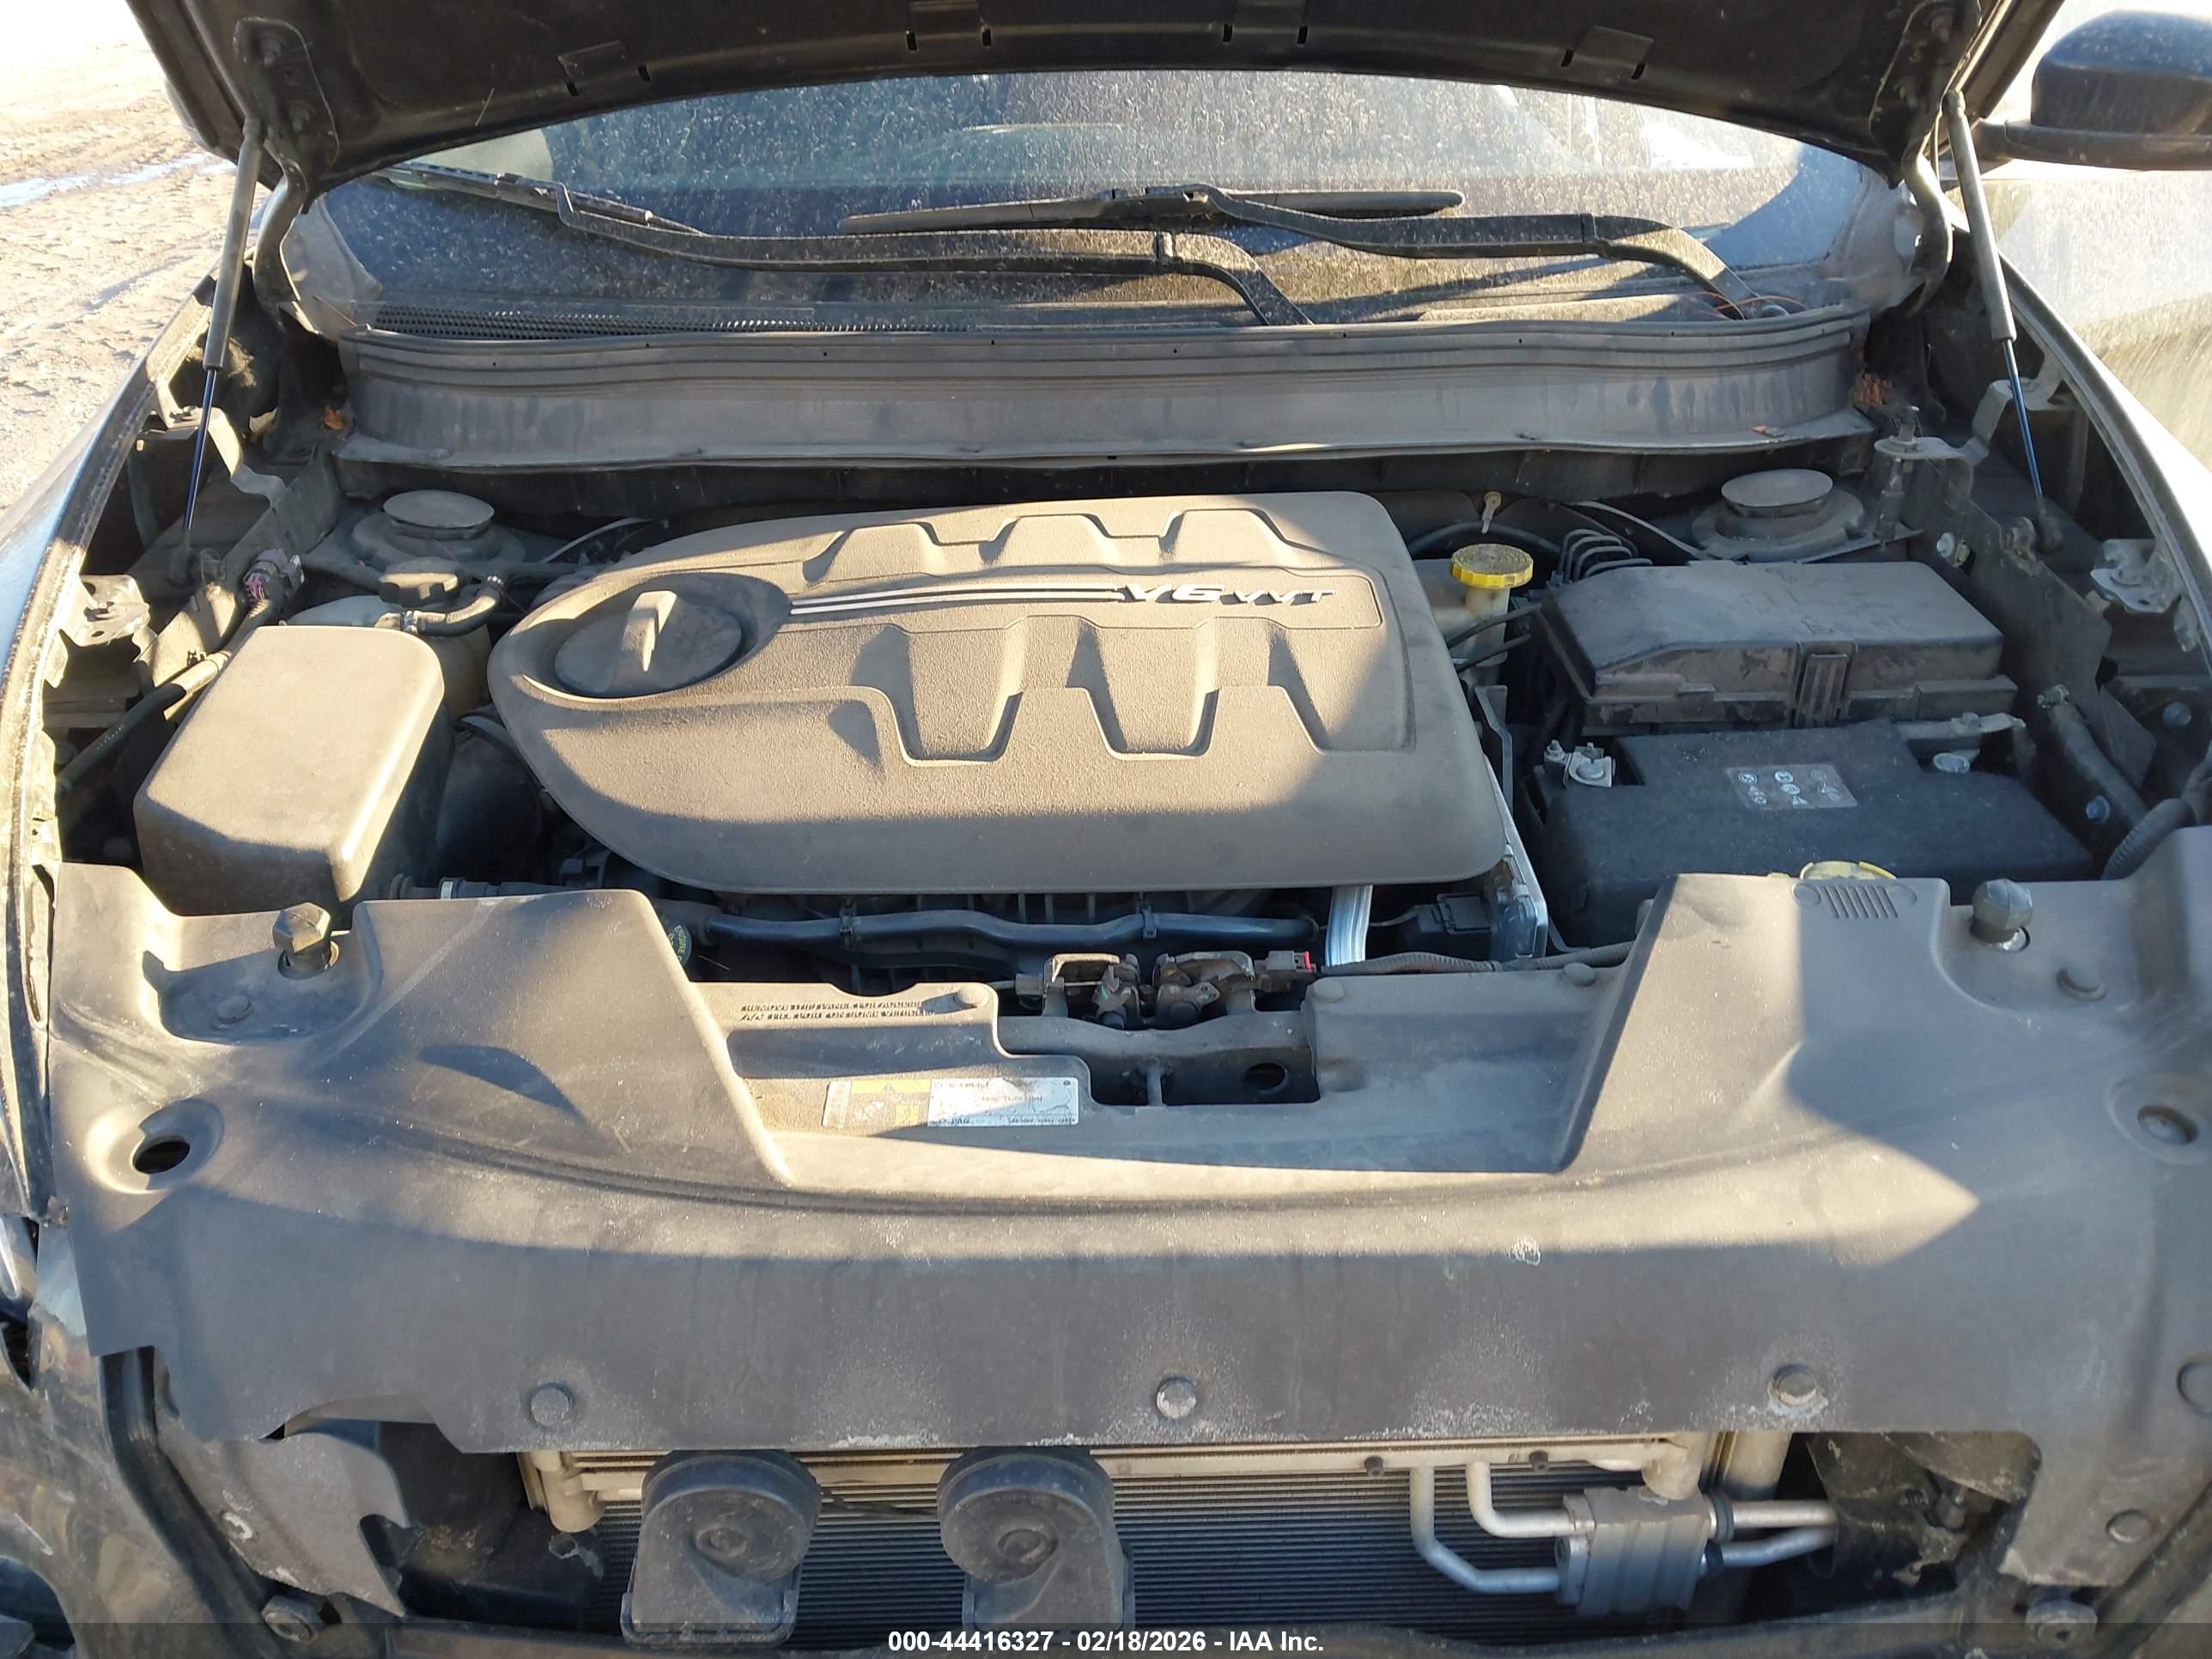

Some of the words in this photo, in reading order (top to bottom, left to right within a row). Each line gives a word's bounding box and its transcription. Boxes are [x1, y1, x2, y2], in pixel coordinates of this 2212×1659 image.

[1125, 584, 1226, 602] V6
[1231, 590, 1336, 604] VVT
[674, 925, 686, 954] ENGINE
